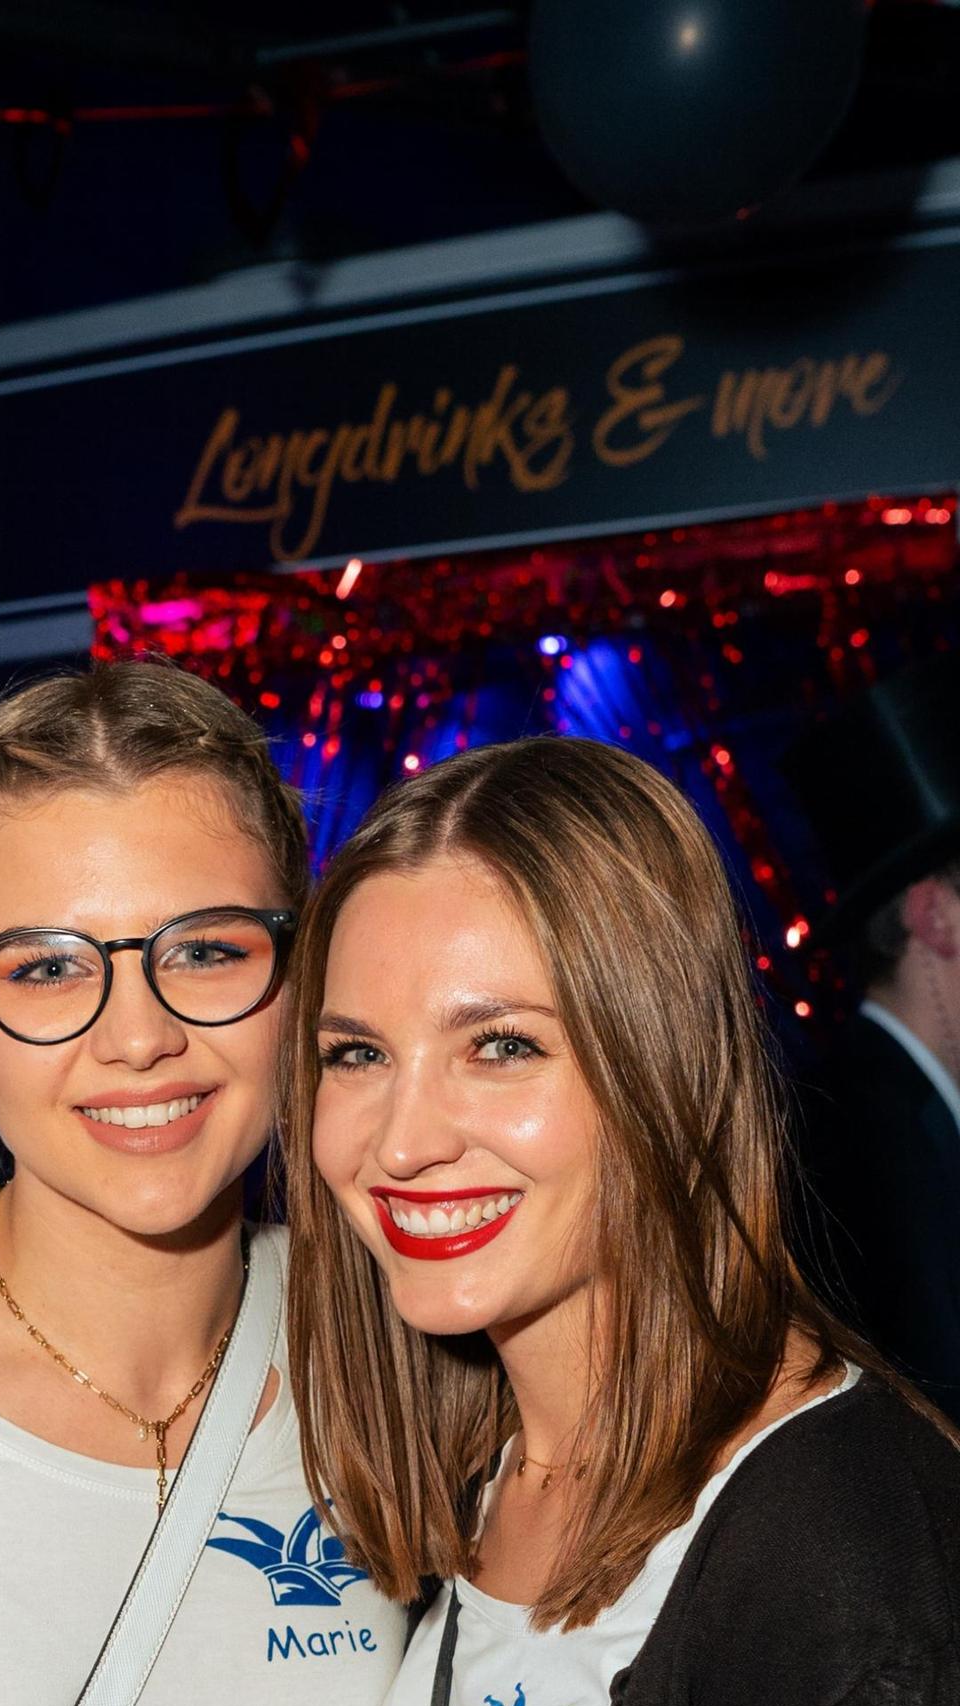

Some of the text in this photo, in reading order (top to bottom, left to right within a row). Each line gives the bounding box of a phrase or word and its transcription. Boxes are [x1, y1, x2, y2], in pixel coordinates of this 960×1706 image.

[174, 334, 900, 561] Longdrinks & more
[267, 1619, 378, 1662] Marie
